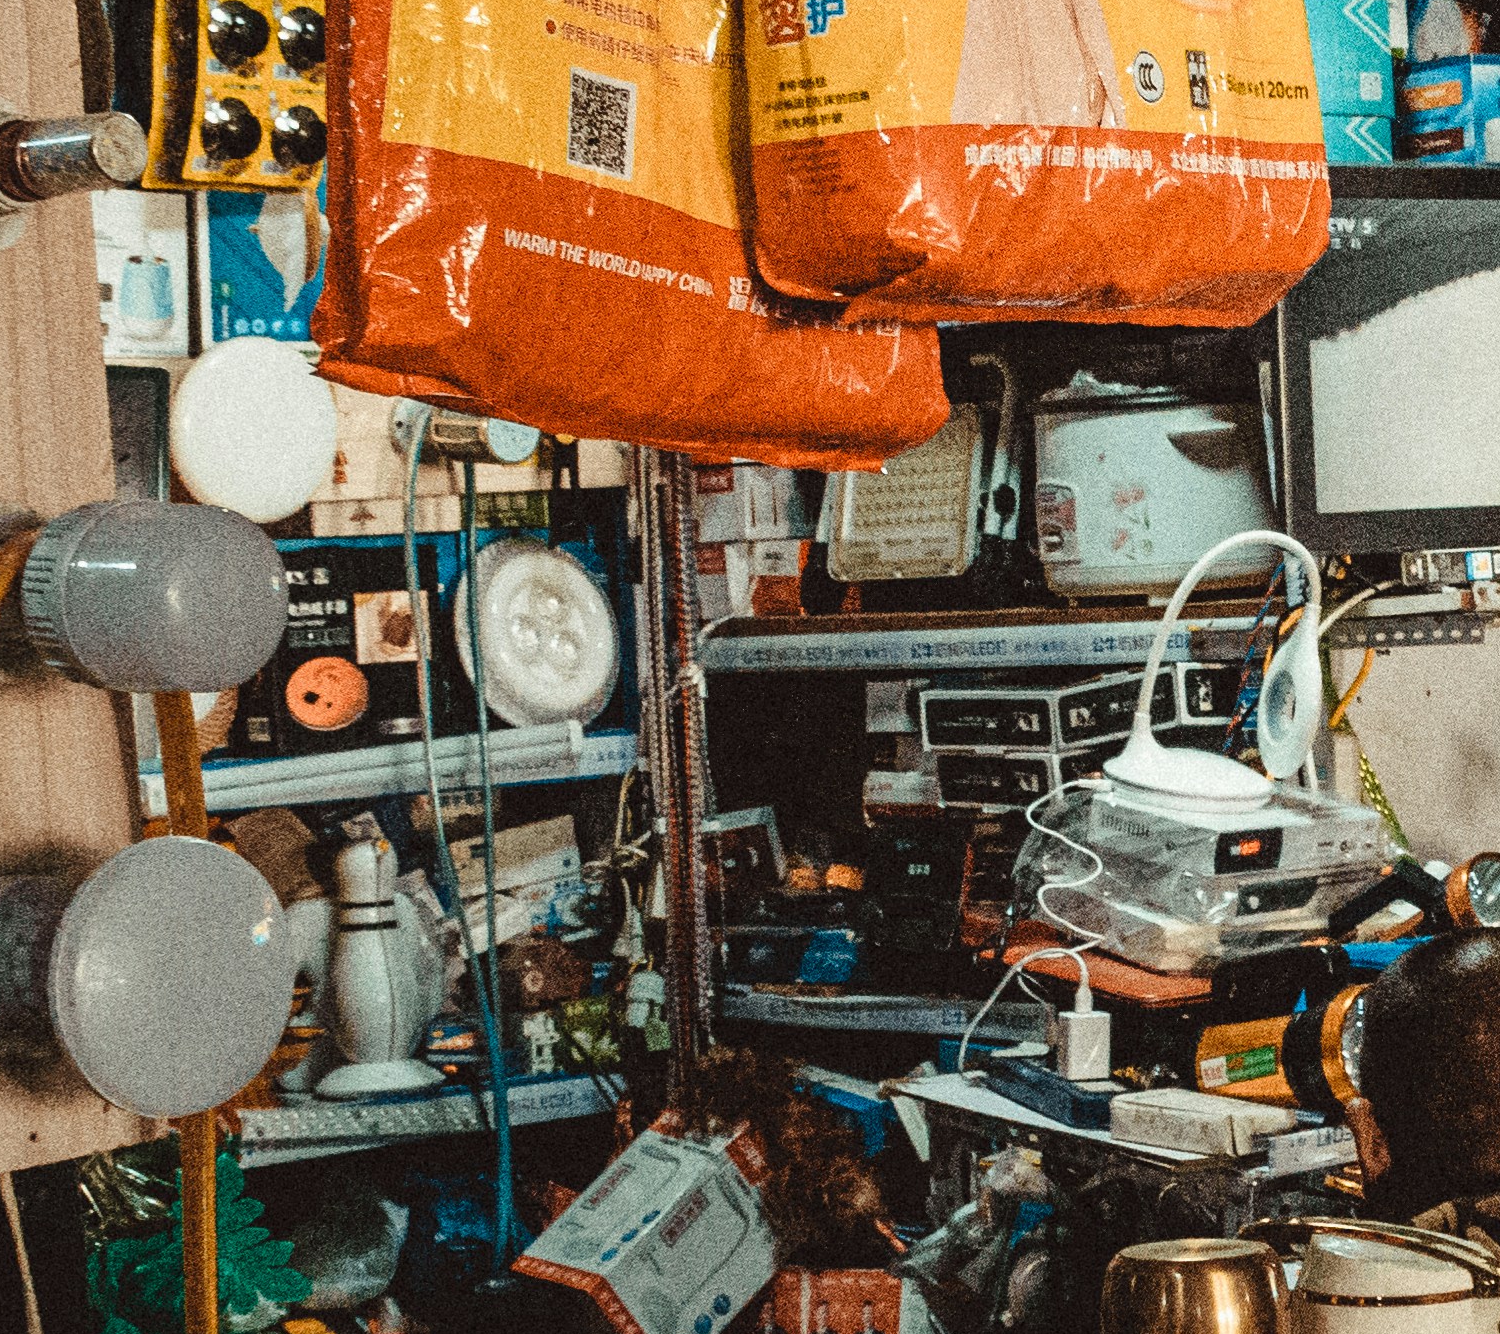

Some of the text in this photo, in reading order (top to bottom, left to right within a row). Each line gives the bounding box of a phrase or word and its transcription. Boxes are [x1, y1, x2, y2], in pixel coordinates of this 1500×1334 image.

[503, 227, 557, 258] WARM
[559, 241, 587, 266] THE
[588, 249, 641, 278] WORLD
